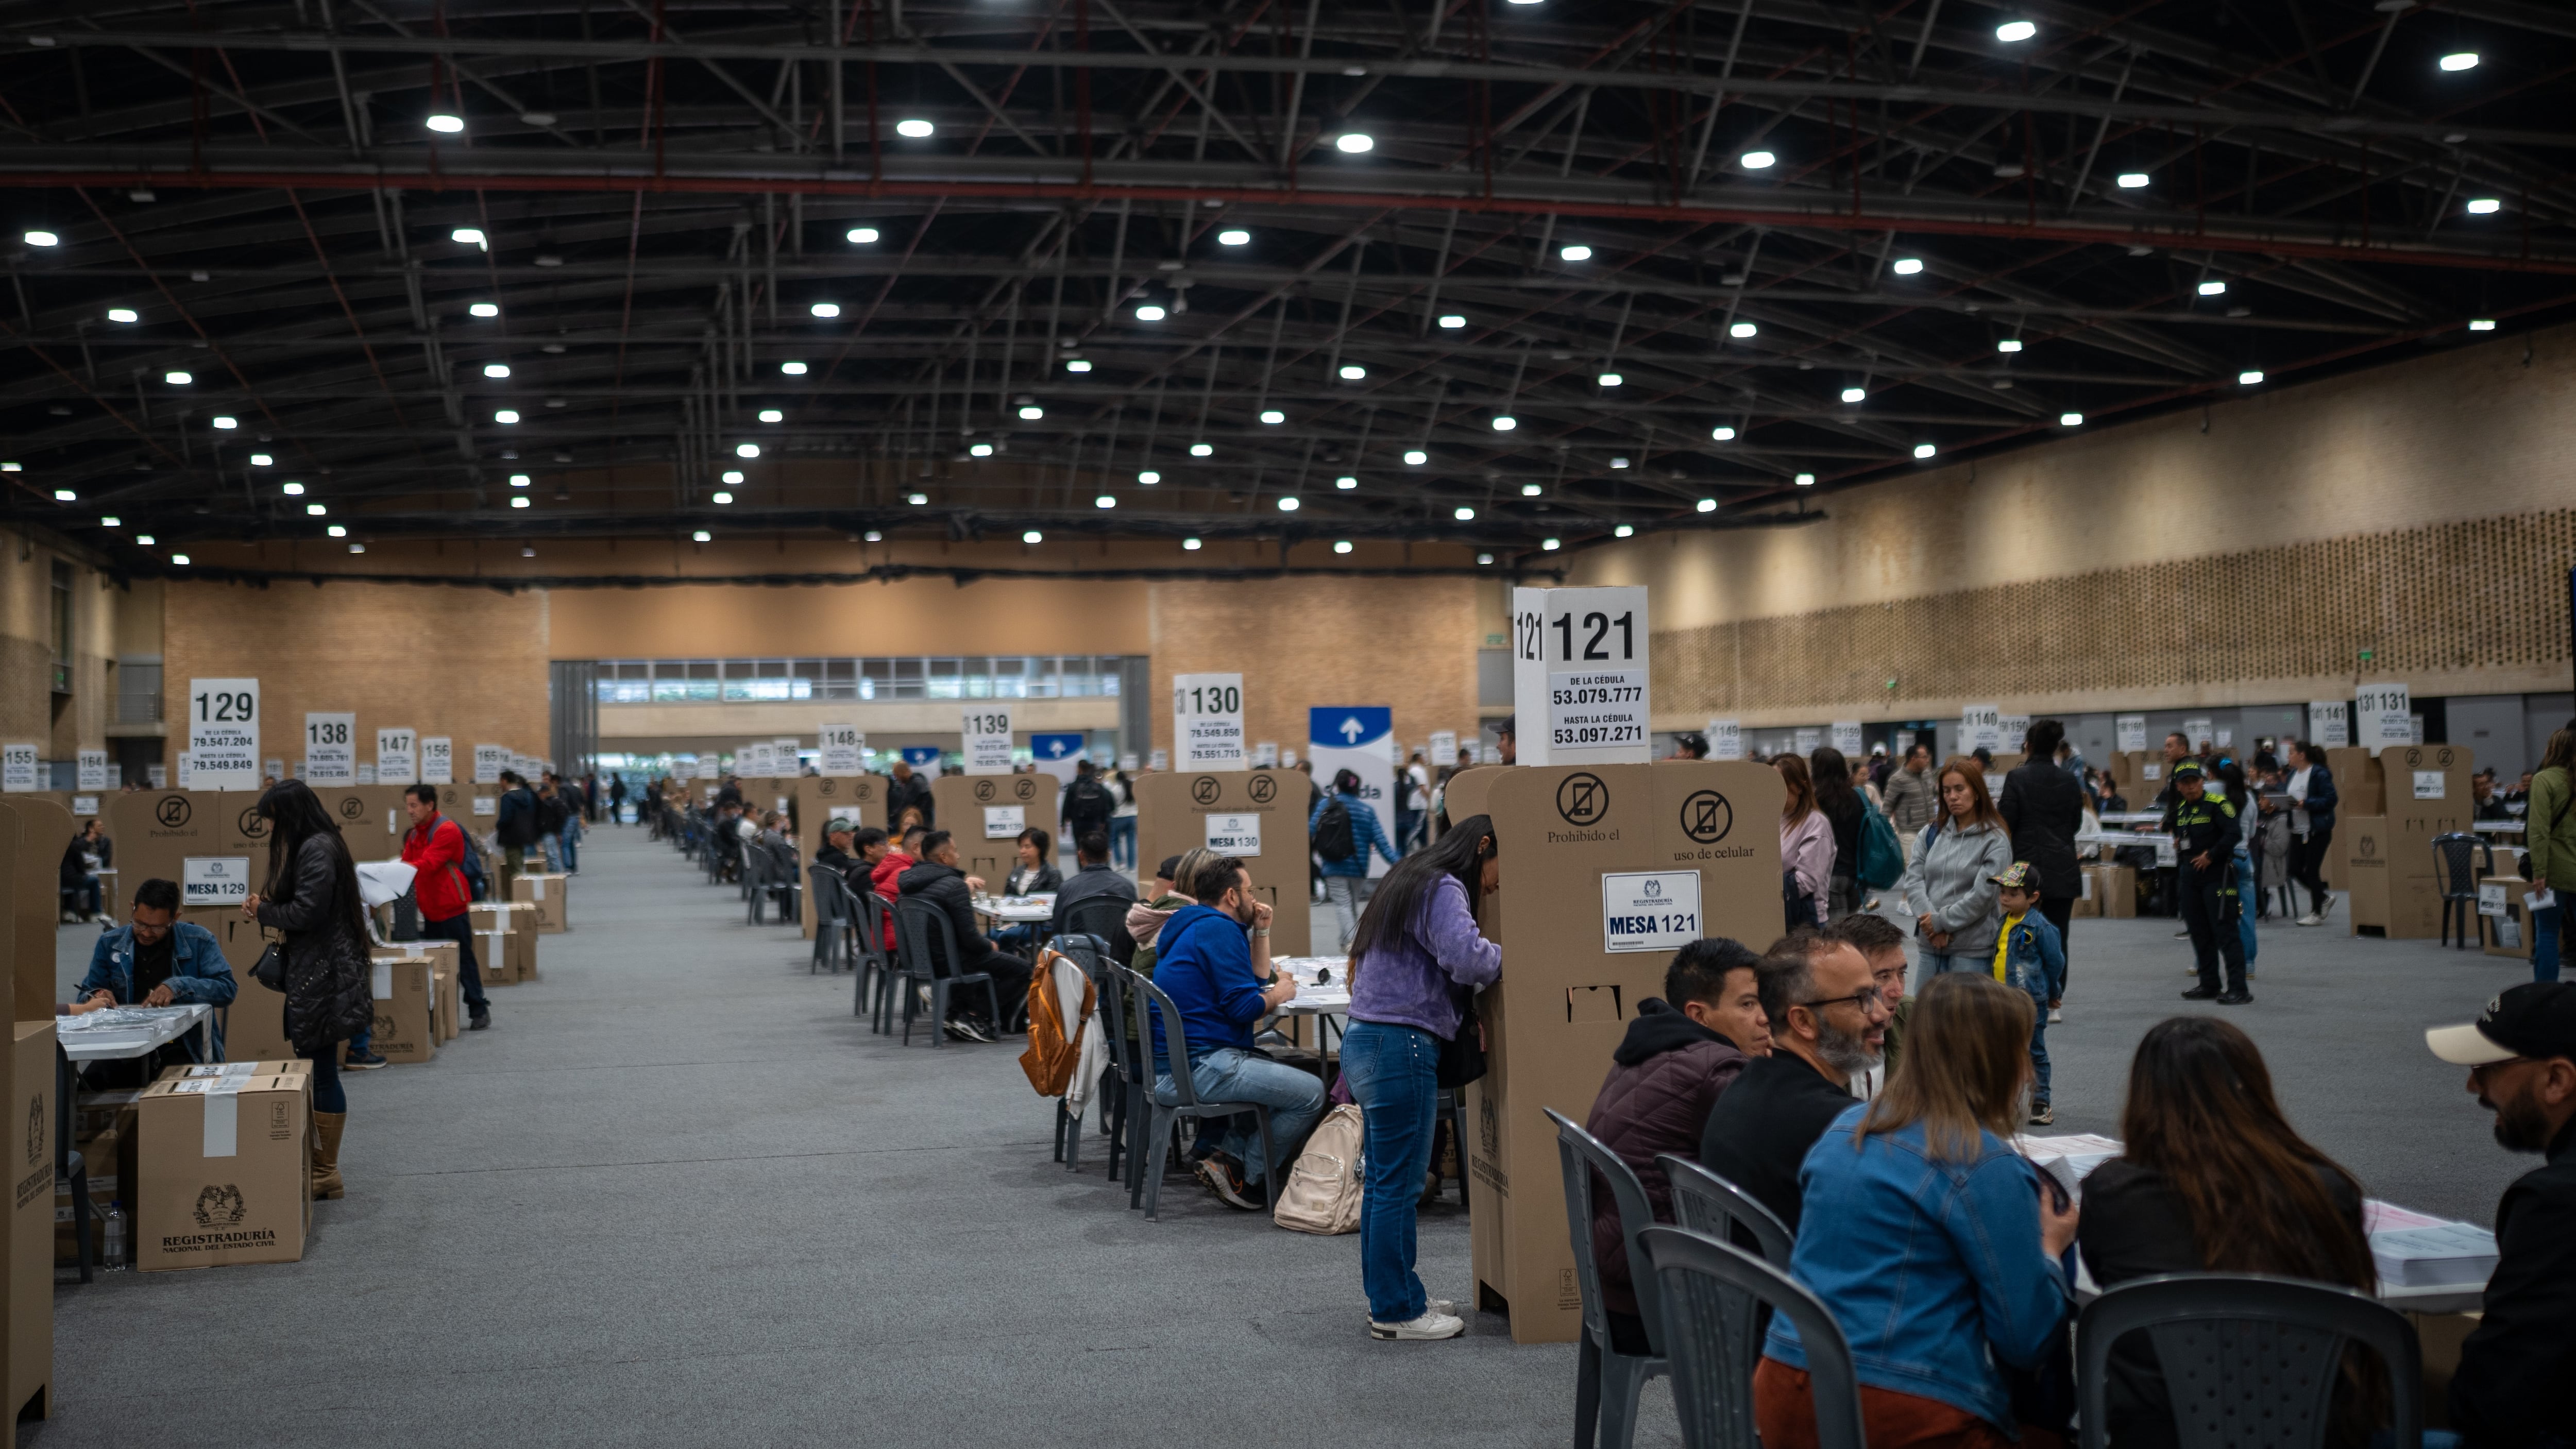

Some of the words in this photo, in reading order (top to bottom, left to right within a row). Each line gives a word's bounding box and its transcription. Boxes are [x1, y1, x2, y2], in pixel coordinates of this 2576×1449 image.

[1517, 611, 1542, 661] 121
[1552, 611, 1633, 661] 121
[1595, 675, 1624, 684] CÉDULA
[1191, 687, 1239, 714] 130
[1553, 687, 1642, 705] 53.079.777
[2358, 693, 2376, 712] 131
[2380, 692, 2407, 710] 131
[195, 692, 253, 722] 129
[2326, 707, 2345, 721] 141
[973, 714, 1008, 734] 139
[1564, 716, 1588, 724] HASTA
[1603, 713, 1633, 722] CÉDULA
[1975, 711, 1998, 727] 140
[309, 723, 347, 744] 138
[1191, 729, 1240, 738] 79.549.850
[1719, 725, 1738, 737] 149
[1843, 727, 1860, 738] 159
[2010, 721, 2028, 732] 150
[828, 730, 855, 746] 148
[1554, 726, 1642, 744] 53.097.271
[194, 738, 253, 747] 79.547.204
[380, 737, 410, 752] 147
[6, 751, 32, 764] 155
[426, 744, 450, 757] 156
[477, 751, 498, 762] 165
[1191, 750, 1241, 759] 79.551.713
[81, 756, 102, 768] 164
[193, 760, 253, 770] 79.549.849
[1324, 784, 1381, 799] Sda
[150, 829, 189, 838] Prohibido
[191, 828, 198, 837] el
[1548, 830, 1606, 843] Prohibido
[1609, 829, 1620, 841] el
[248, 840, 258, 849] de
[1209, 838, 1236, 847] MESA
[1238, 837, 1258, 847] 130
[1674, 850, 1694, 861] uso
[1698, 848, 1711, 860] de
[1715, 846, 1755, 859] celular
[188, 884, 218, 894] MESA
[222, 883, 245, 894] 129
[1609, 915, 1658, 935] MESA
[1662, 913, 1695, 933] 121
[1471, 1154, 1509, 1189] REGISTRADURÍA
[163, 1228, 276, 1246] REGISTRADURÍA
[163, 1245, 202, 1253] NACIONAL
